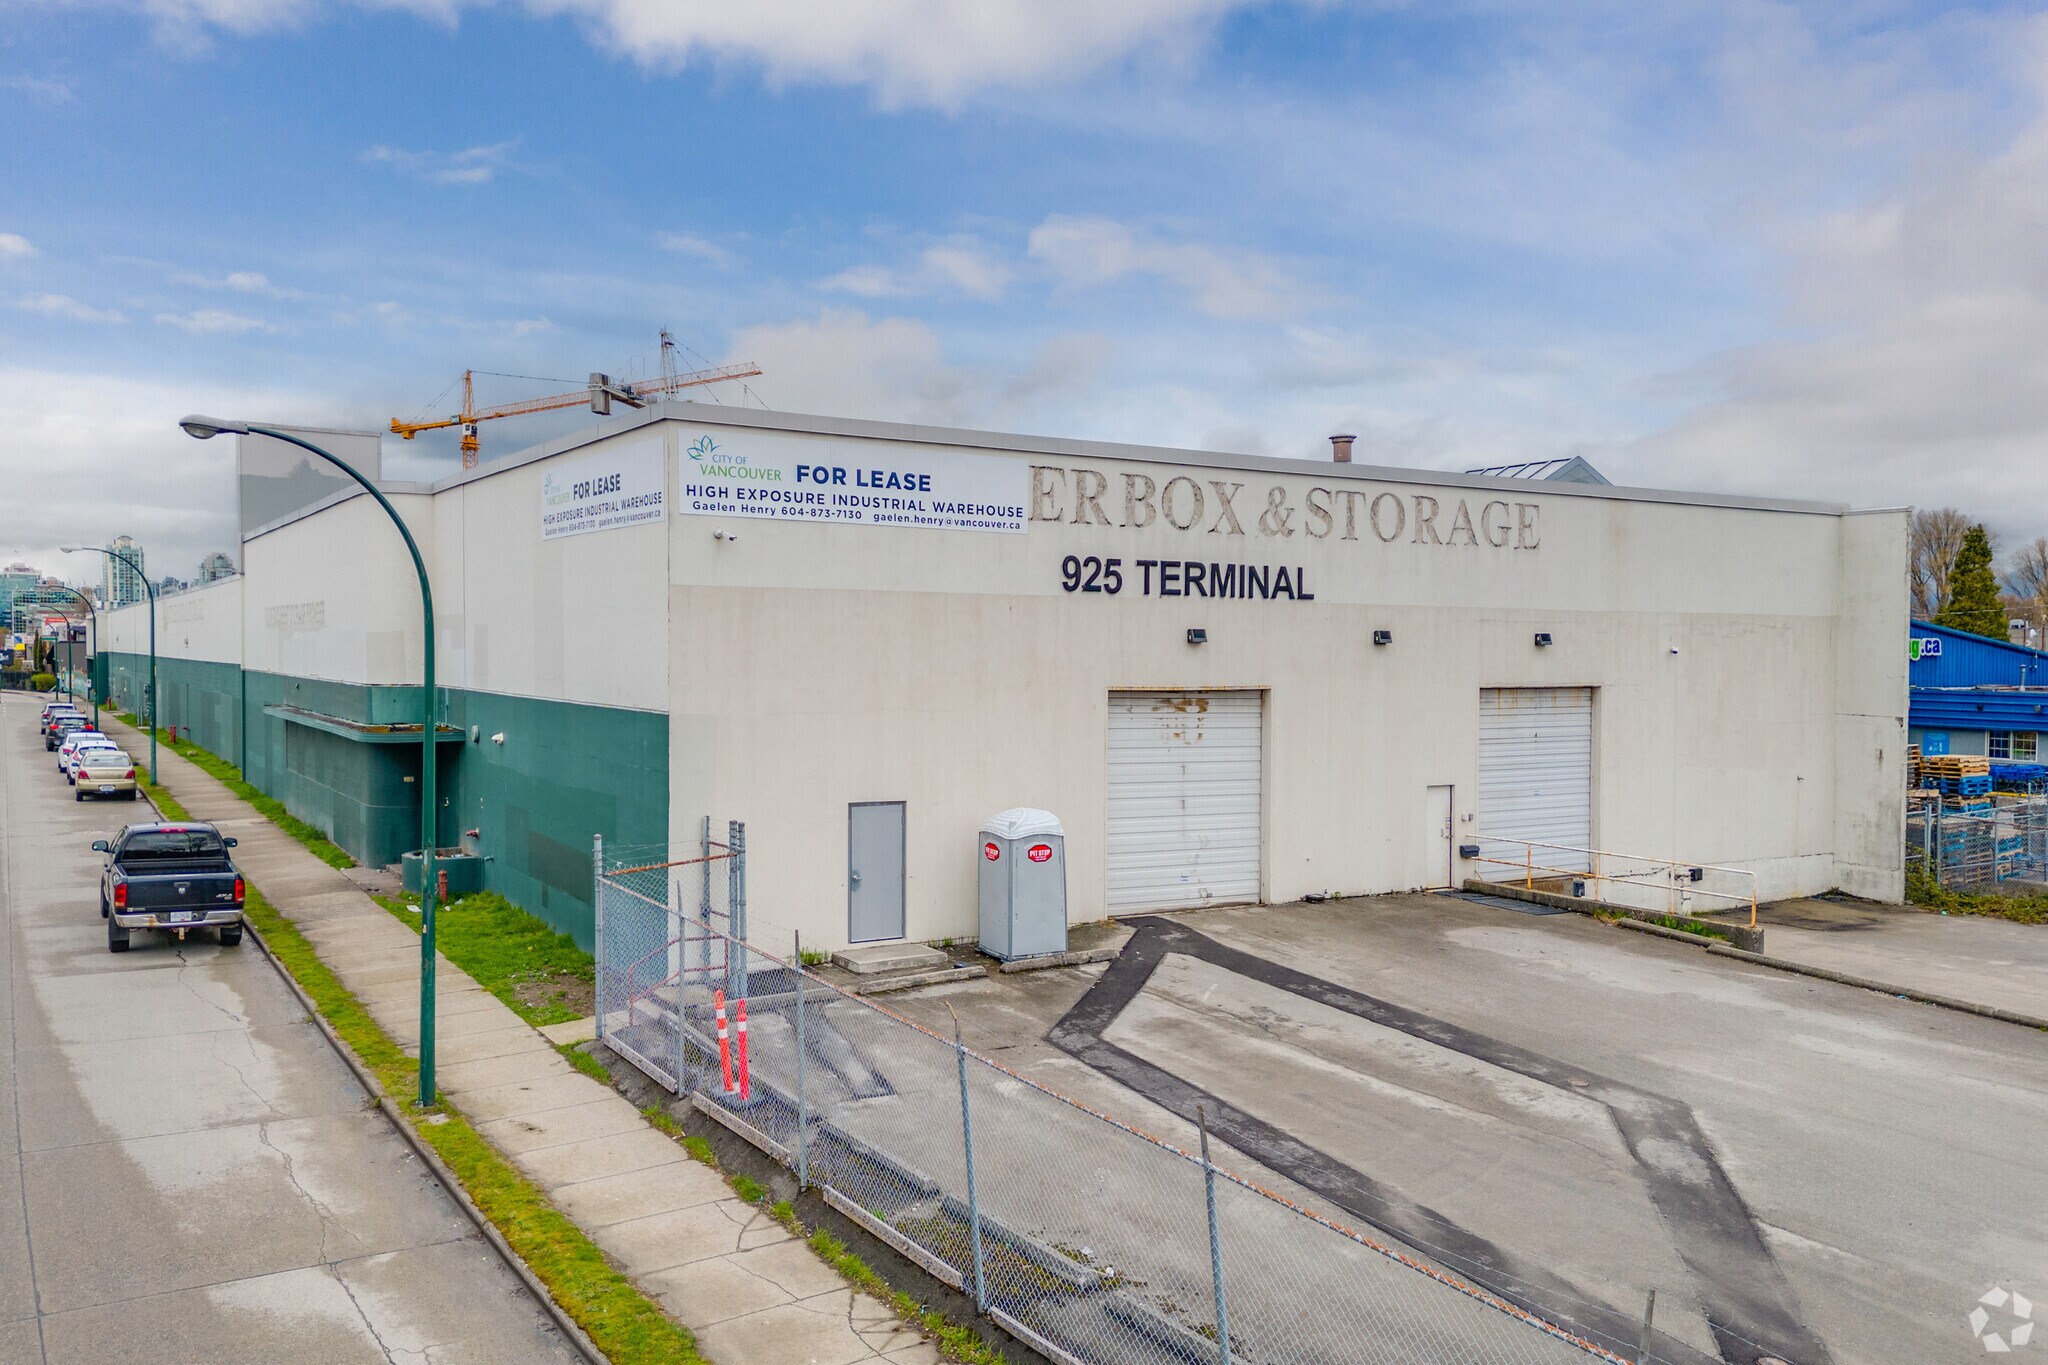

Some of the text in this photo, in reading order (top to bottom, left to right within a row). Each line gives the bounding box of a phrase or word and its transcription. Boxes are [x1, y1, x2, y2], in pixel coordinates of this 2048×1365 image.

[700, 464, 782, 481] VANCOUVER
[712, 454, 747, 465] CITY OF
[573, 473, 621, 501] FOR LEASE
[796, 464, 931, 492] FOR LEASE
[543, 491, 662, 525] HIGH EXPOSURE INDUSTRIAL WAREHOUSE
[686, 484, 1023, 518] HIGH EXPOSURE INDUSTRIAL WAREHOUSE
[692, 501, 1021, 530] Gaelen Henry 604-873-7130 gaelen.henry@vancouver.ca
[1304, 487, 1541, 550] STORAGE
[1062, 556, 1314, 600] 925 TERMINAL
[1909, 640, 1941, 659] g.ca
